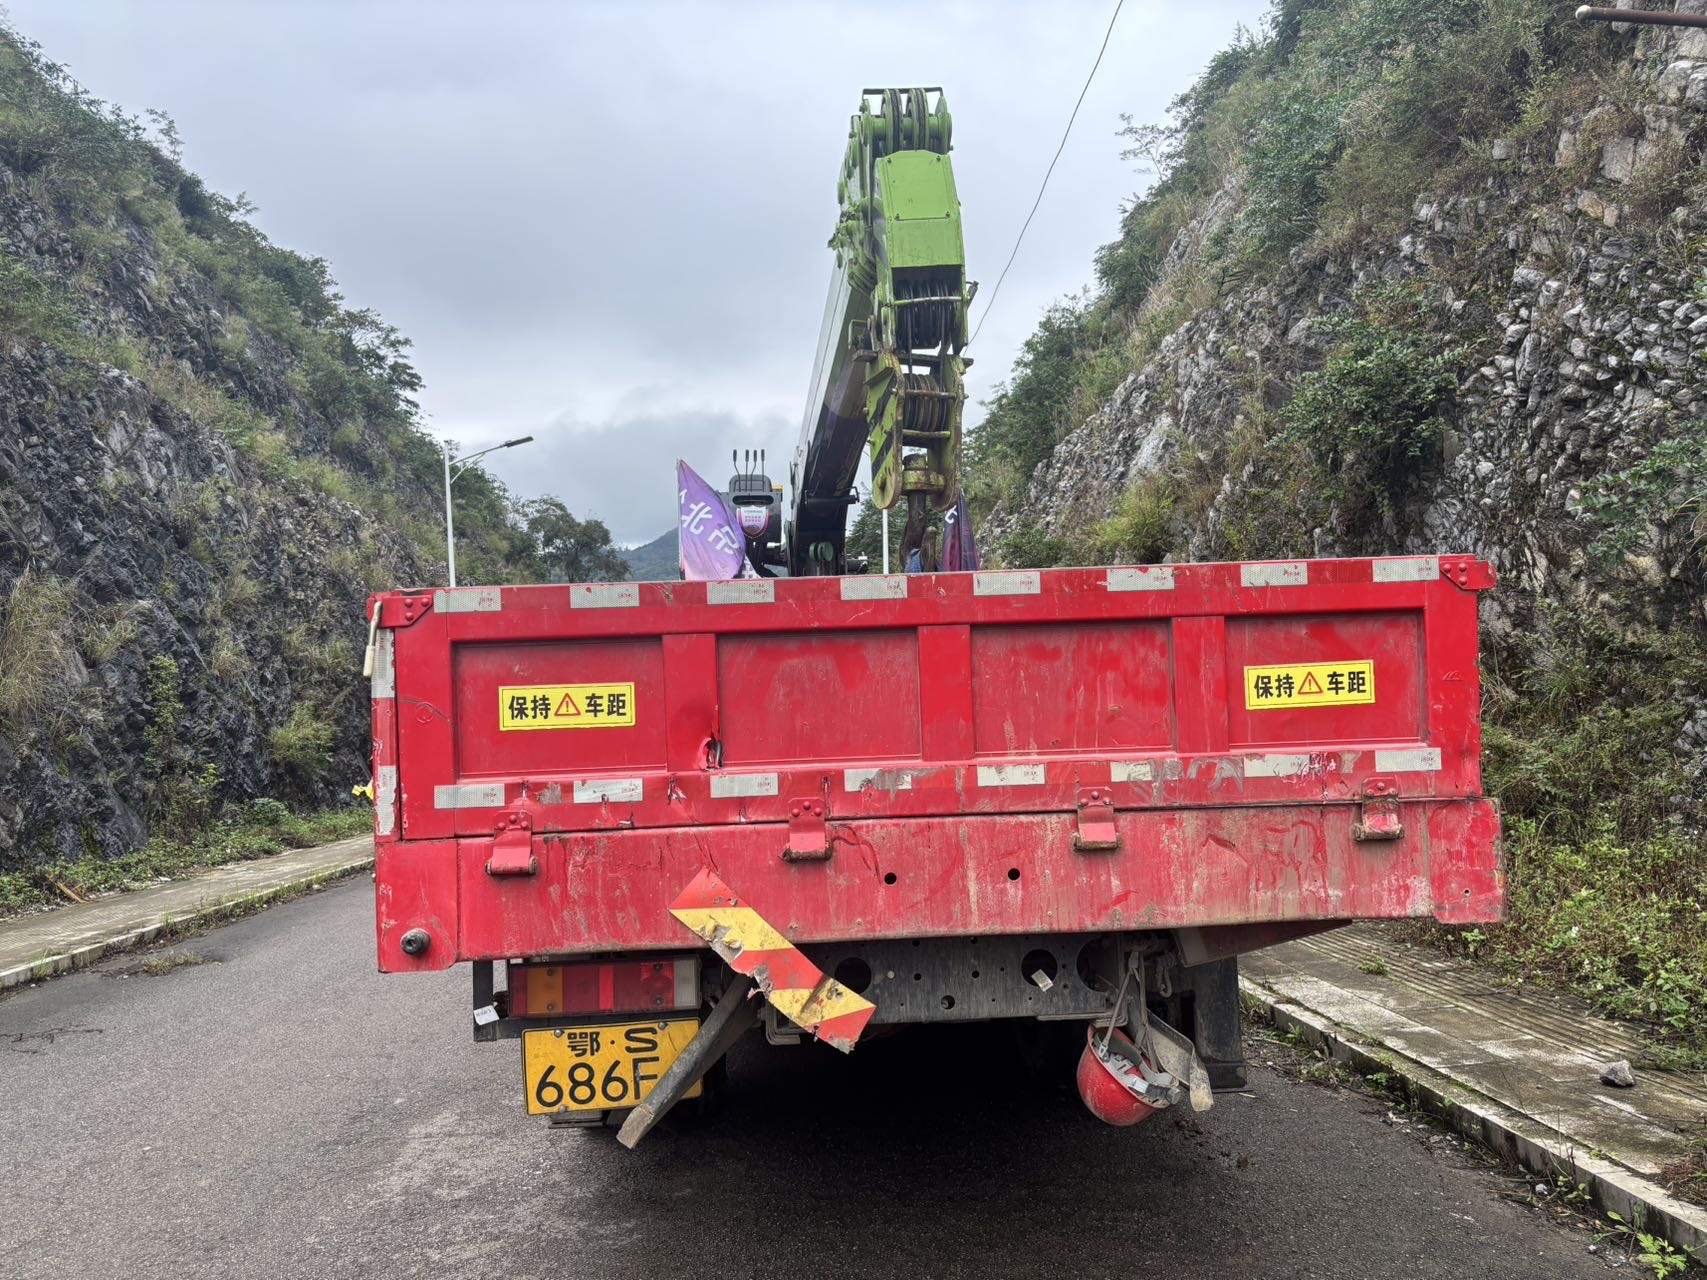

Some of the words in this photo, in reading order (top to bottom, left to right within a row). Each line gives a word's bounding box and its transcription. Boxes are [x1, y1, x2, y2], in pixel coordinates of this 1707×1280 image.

[1253, 673, 1295, 699] 保持
[1326, 670, 1367, 695] 车距
[508, 694, 551, 720] 保持
[585, 692, 627, 718] 车距
[535, 1056, 660, 1108] 686F
